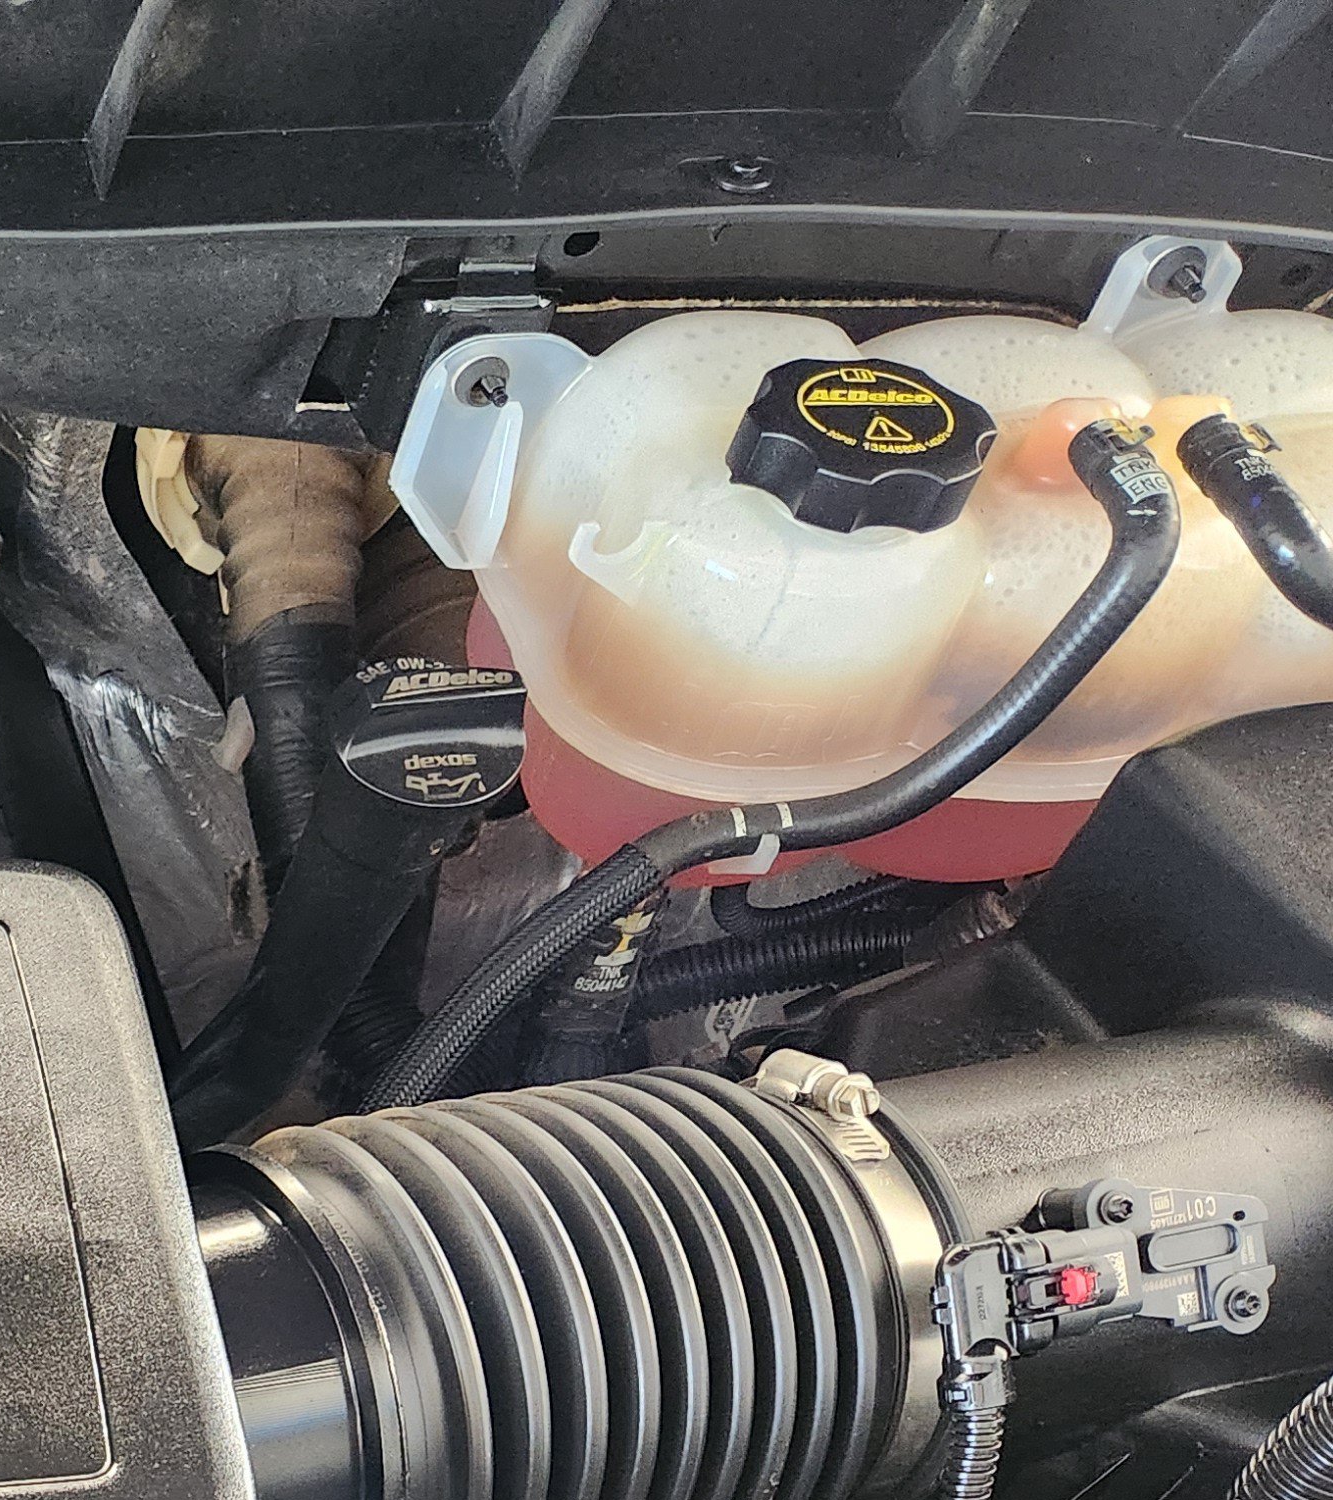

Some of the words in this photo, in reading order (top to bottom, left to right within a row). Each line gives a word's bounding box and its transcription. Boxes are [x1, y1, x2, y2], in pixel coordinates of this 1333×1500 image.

[806, 389, 935, 403] ACDelco
[1128, 473, 1169, 497] ENG
[356, 661, 392, 684] SAE
[385, 669, 514, 695] ACDelco
[404, 753, 479, 771] dexos
[598, 965, 624, 980] TNK
